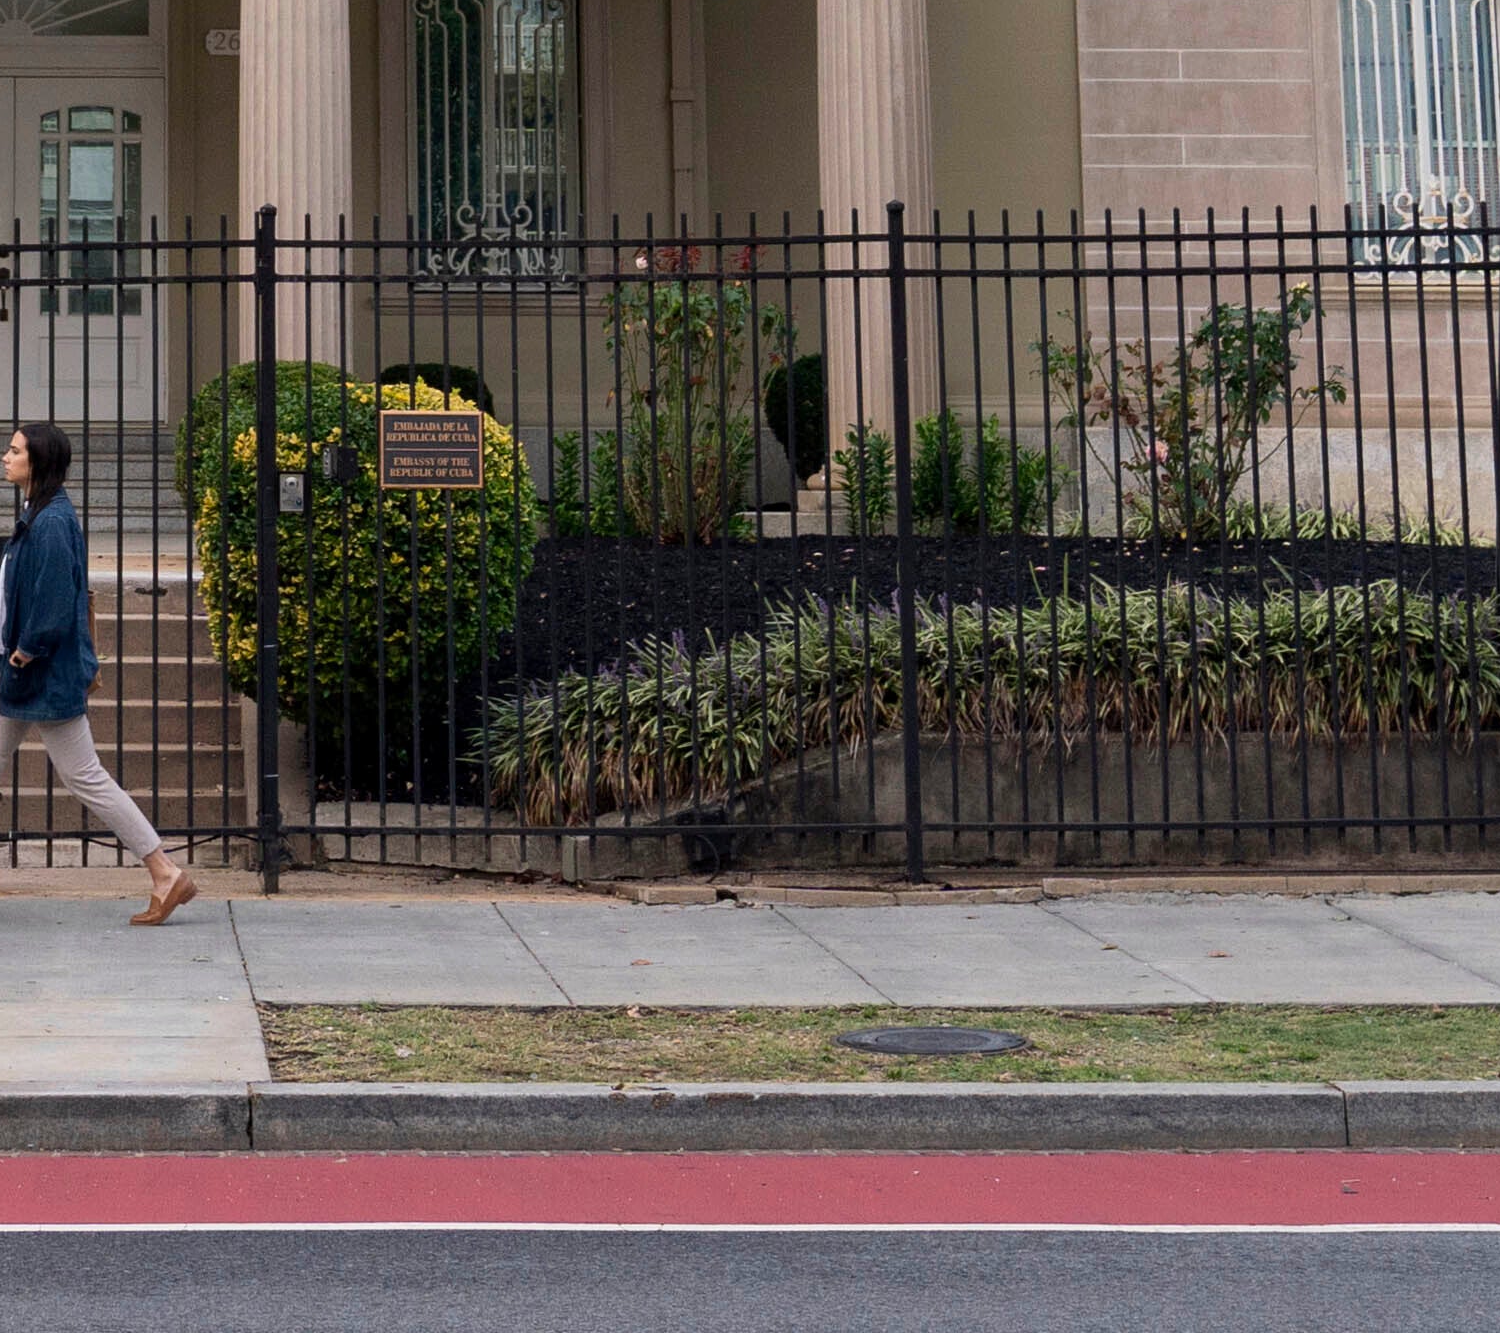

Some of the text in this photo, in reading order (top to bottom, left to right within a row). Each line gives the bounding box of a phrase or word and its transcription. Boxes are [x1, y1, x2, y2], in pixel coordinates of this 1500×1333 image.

[393, 421, 469, 431] EMBAJADA DE LA
[386, 433, 477, 442] REPUBLICA DE CUBA
[393, 457, 470, 466] EMBASSY OF THE
[389, 468, 474, 478] REPUBLIC OF CUBA
